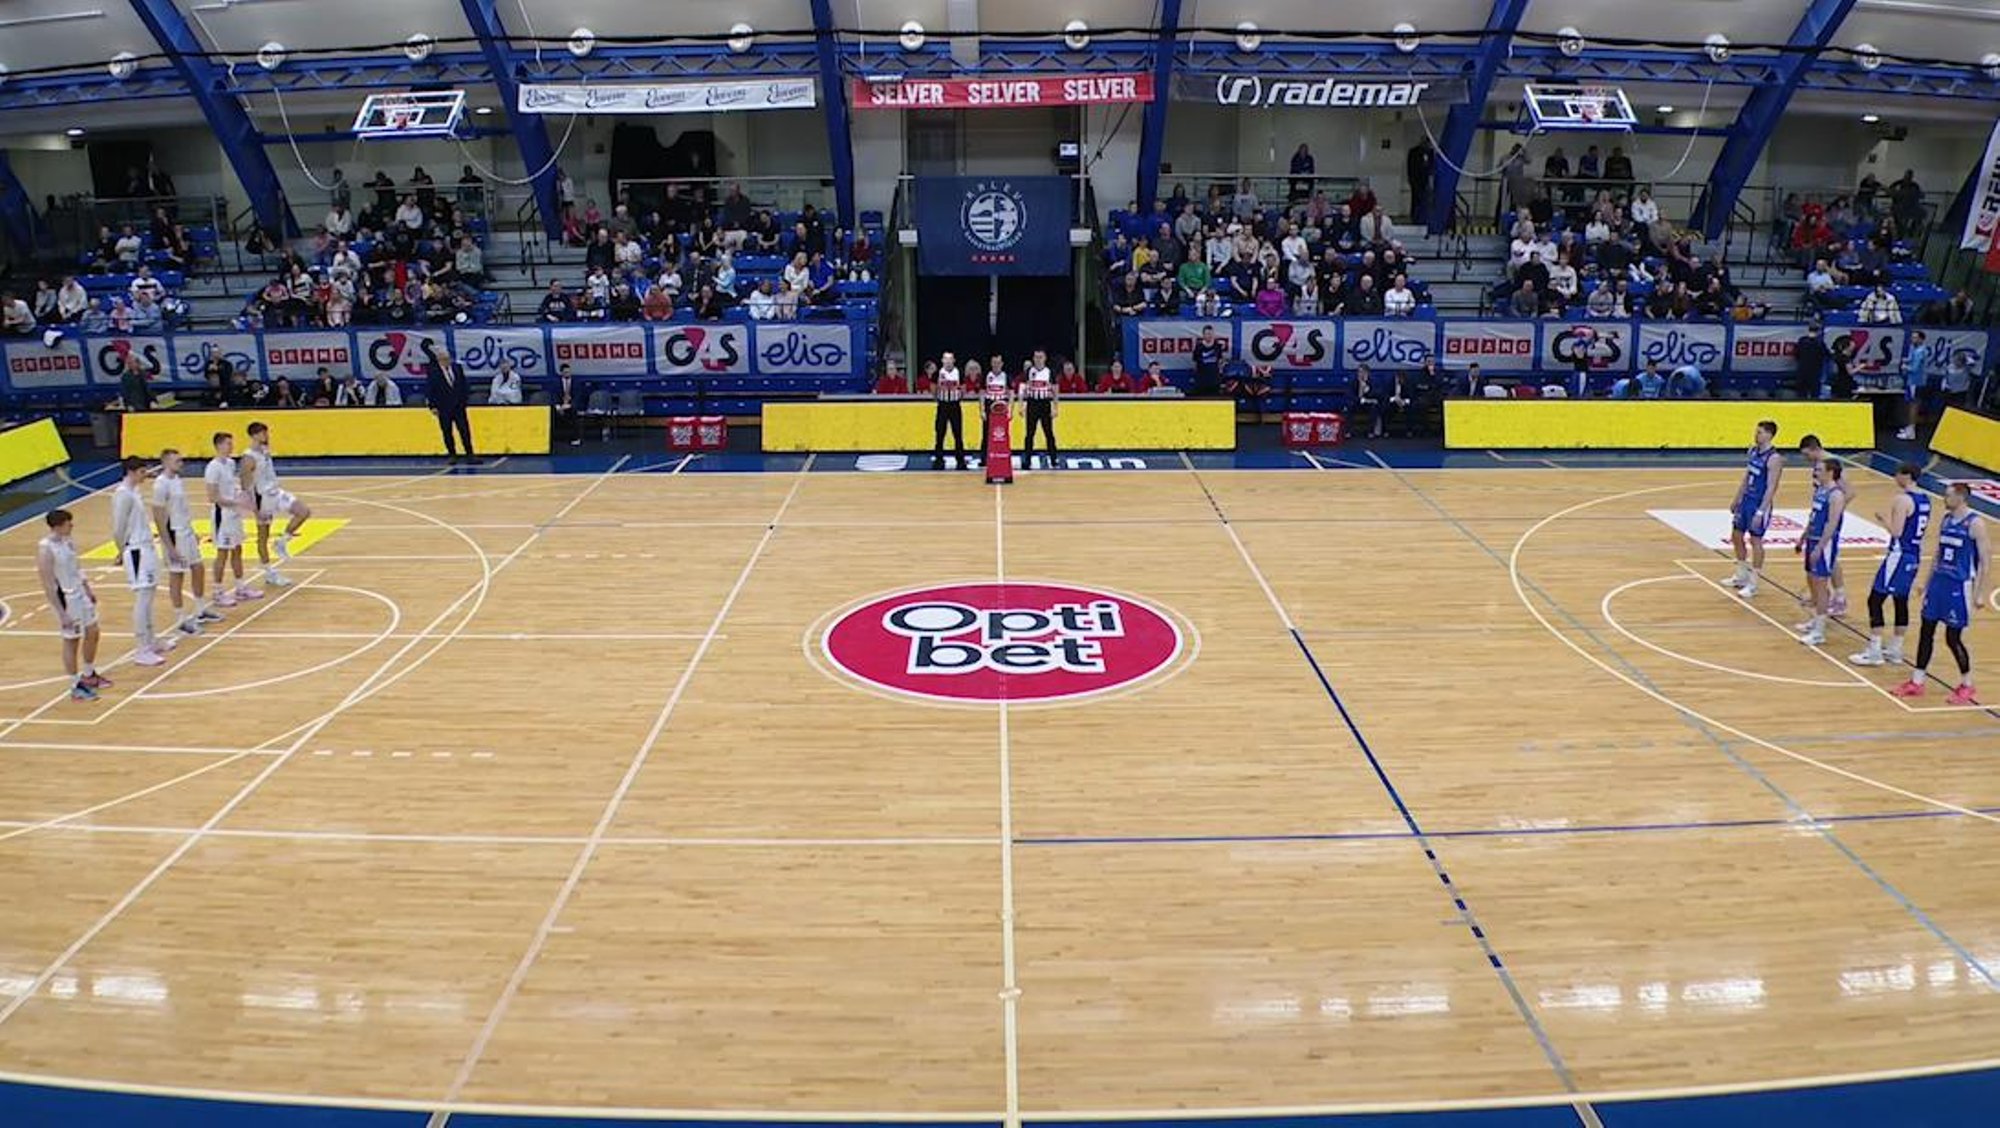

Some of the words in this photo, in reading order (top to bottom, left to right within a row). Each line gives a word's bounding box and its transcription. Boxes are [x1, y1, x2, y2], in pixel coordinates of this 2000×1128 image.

[871, 83, 944, 105] SELVER
[968, 81, 1040, 103] SELVER
[1064, 78, 1137, 101] SELVER
[1266, 78, 1429, 106] rademar
[269, 348, 348, 365] CRAMO
[556, 343, 643, 360] CRAMO
[665, 327, 739, 371] G4S
[761, 332, 848, 367] elisa
[1252, 323, 1325, 367] G4S
[1347, 328, 1432, 363] elisa
[1446, 338, 1531, 354] CRAMO
[1642, 330, 1721, 365] elisa
[1736, 341, 1799, 356] CRAM
[11, 355, 81, 373] CRAMO
[888, 602, 1118, 640] Opti
[913, 636, 1098, 668] bet
